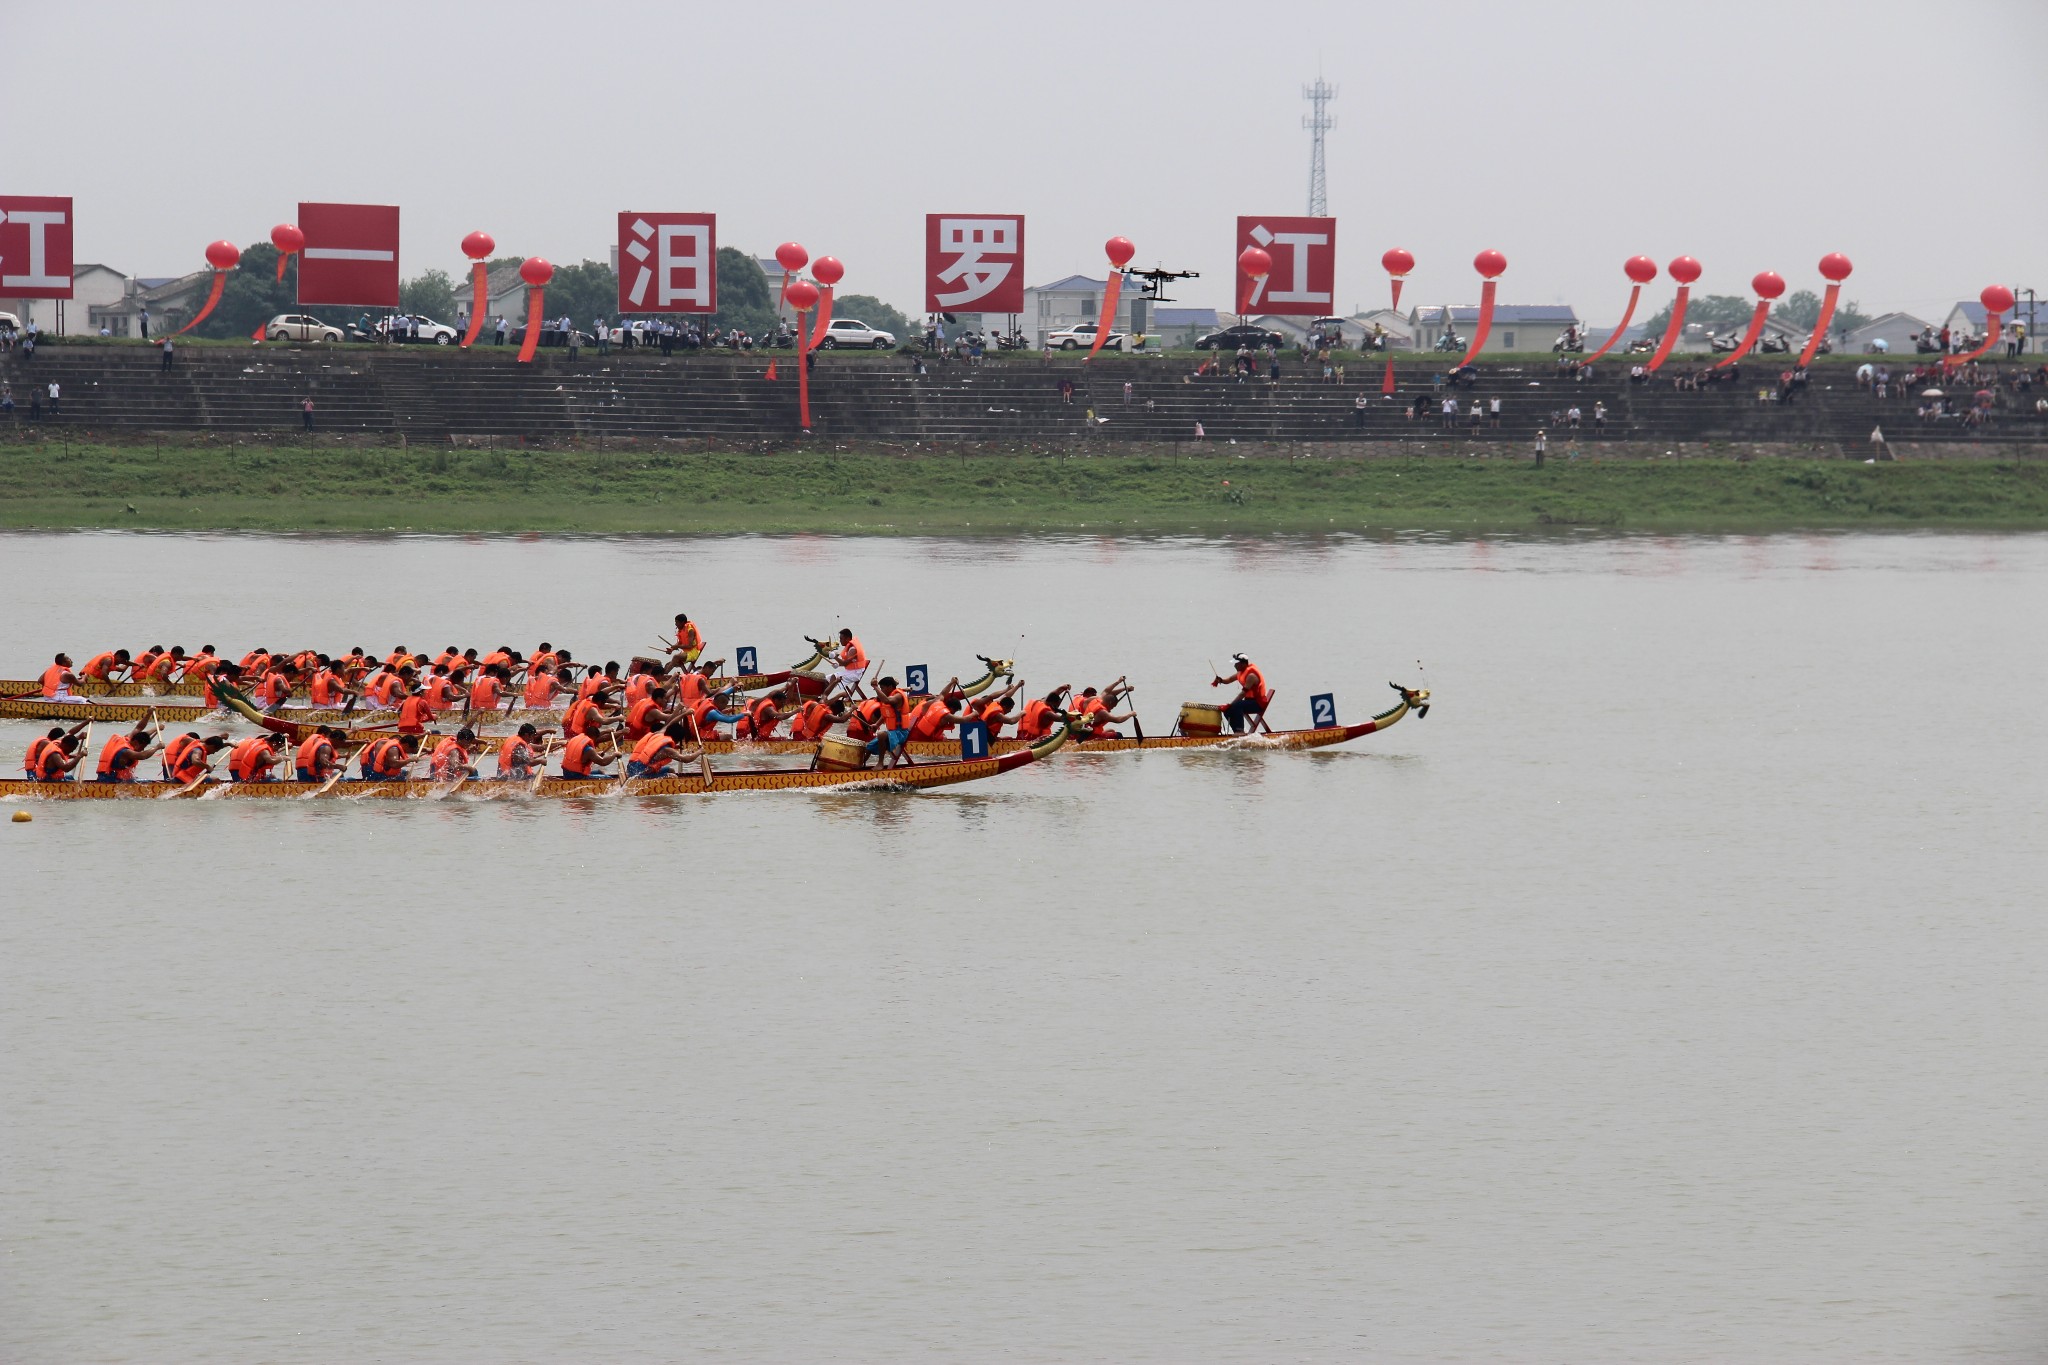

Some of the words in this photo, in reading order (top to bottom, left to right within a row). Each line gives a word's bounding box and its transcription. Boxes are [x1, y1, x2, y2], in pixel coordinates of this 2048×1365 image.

[304, 247, 394, 262] 一
[625, 218, 710, 307] 汨
[933, 219, 1019, 307] 罗
[1239, 224, 1331, 307] 江
[740, 650, 755, 670] 4
[910, 670, 925, 691] 3
[1315, 699, 1333, 723] 2
[966, 728, 980, 754] 1
